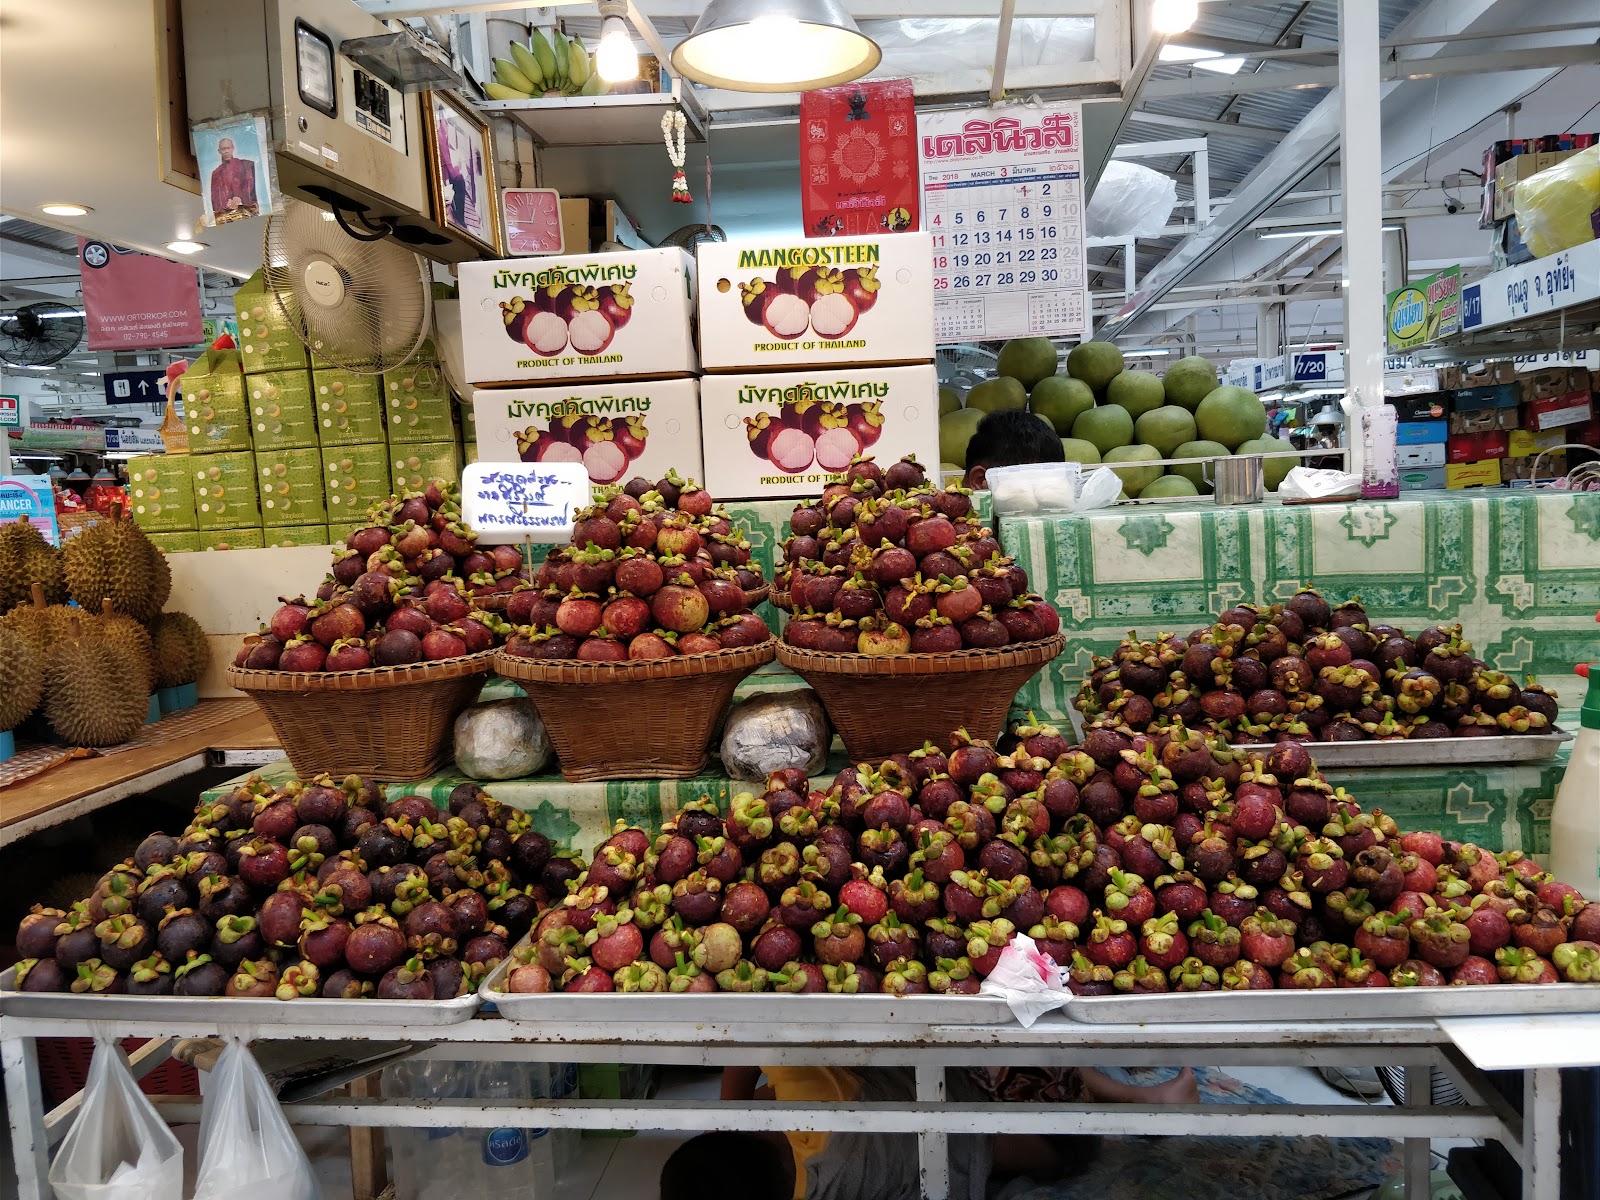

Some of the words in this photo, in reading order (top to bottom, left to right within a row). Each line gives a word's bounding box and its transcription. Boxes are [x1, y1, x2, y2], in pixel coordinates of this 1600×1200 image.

[922, 112, 1073, 159] เดลินิวส์
[942, 173, 959, 181] 2018
[971, 170, 996, 179] MARCH
[1000, 168, 1008, 177] 3
[1012, 166, 1037, 175] มีนาคม
[1020, 185, 1027, 197] 1
[1042, 184, 1051, 196] 2
[1064, 182, 1073, 194] 3
[514, 194, 525, 206] 11
[525, 193, 534, 206] 12
[538, 195, 544, 206] 1
[507, 203, 517, 216] 10
[543, 206, 554, 216] 2
[933, 215, 942, 226] 4
[955, 213, 963, 225] 5
[976, 211, 985, 222] 6
[999, 209, 1007, 221] 7
[1021, 207, 1030, 219] 8
[1043, 205, 1052, 217] 9
[1062, 204, 1078, 216] 10
[546, 230, 556, 238] 4
[933, 235, 945, 248] 11
[952, 233, 968, 246] 12
[974, 232, 990, 244] 13
[996, 230, 1012, 242] 14
[1018, 228, 1035, 240] 15
[1040, 226, 1057, 239] 16
[1062, 225, 1078, 237] 17
[520, 238, 528, 250] 7
[532, 240, 538, 252] 6
[541, 239, 549, 250] 5
[737, 244, 880, 269] MANGOSTEEN
[933, 256, 948, 269] 18
[953, 255, 969, 267] 19
[974, 253, 991, 265] 20
[996, 251, 1012, 263] 21
[1018, 249, 1035, 261] 22
[1040, 248, 1057, 260] 23
[1062, 246, 1080, 258] 24
[493, 263, 638, 292] มังคุดคัดพิเศษ
[934, 278, 949, 290] 25
[953, 276, 970, 288] 26
[975, 274, 992, 286] 27
[997, 272, 1014, 285] 28
[1019, 271, 1036, 283] 29
[1041, 269, 1058, 281] 30
[1063, 267, 1079, 279] 31
[1464, 297, 1480, 317] 6/17
[123, 331, 169, 341] 02-790-4545
[753, 341, 799, 352] PRODUCT
[802, 341, 816, 350] OF
[818, 339, 867, 349] THAILAND
[517, 358, 559, 369] PRODUCT
[563, 357, 575, 366] OF
[577, 354, 623, 365] THAILAND
[1297, 361, 1325, 374] 7/20
[738, 381, 889, 407] มังคุดคัดพิเศษ
[507, 395, 652, 422] มังคุดคัดพิเศษ
[760, 475, 805, 485] PRODUCT
[807, 474, 821, 483] OF
